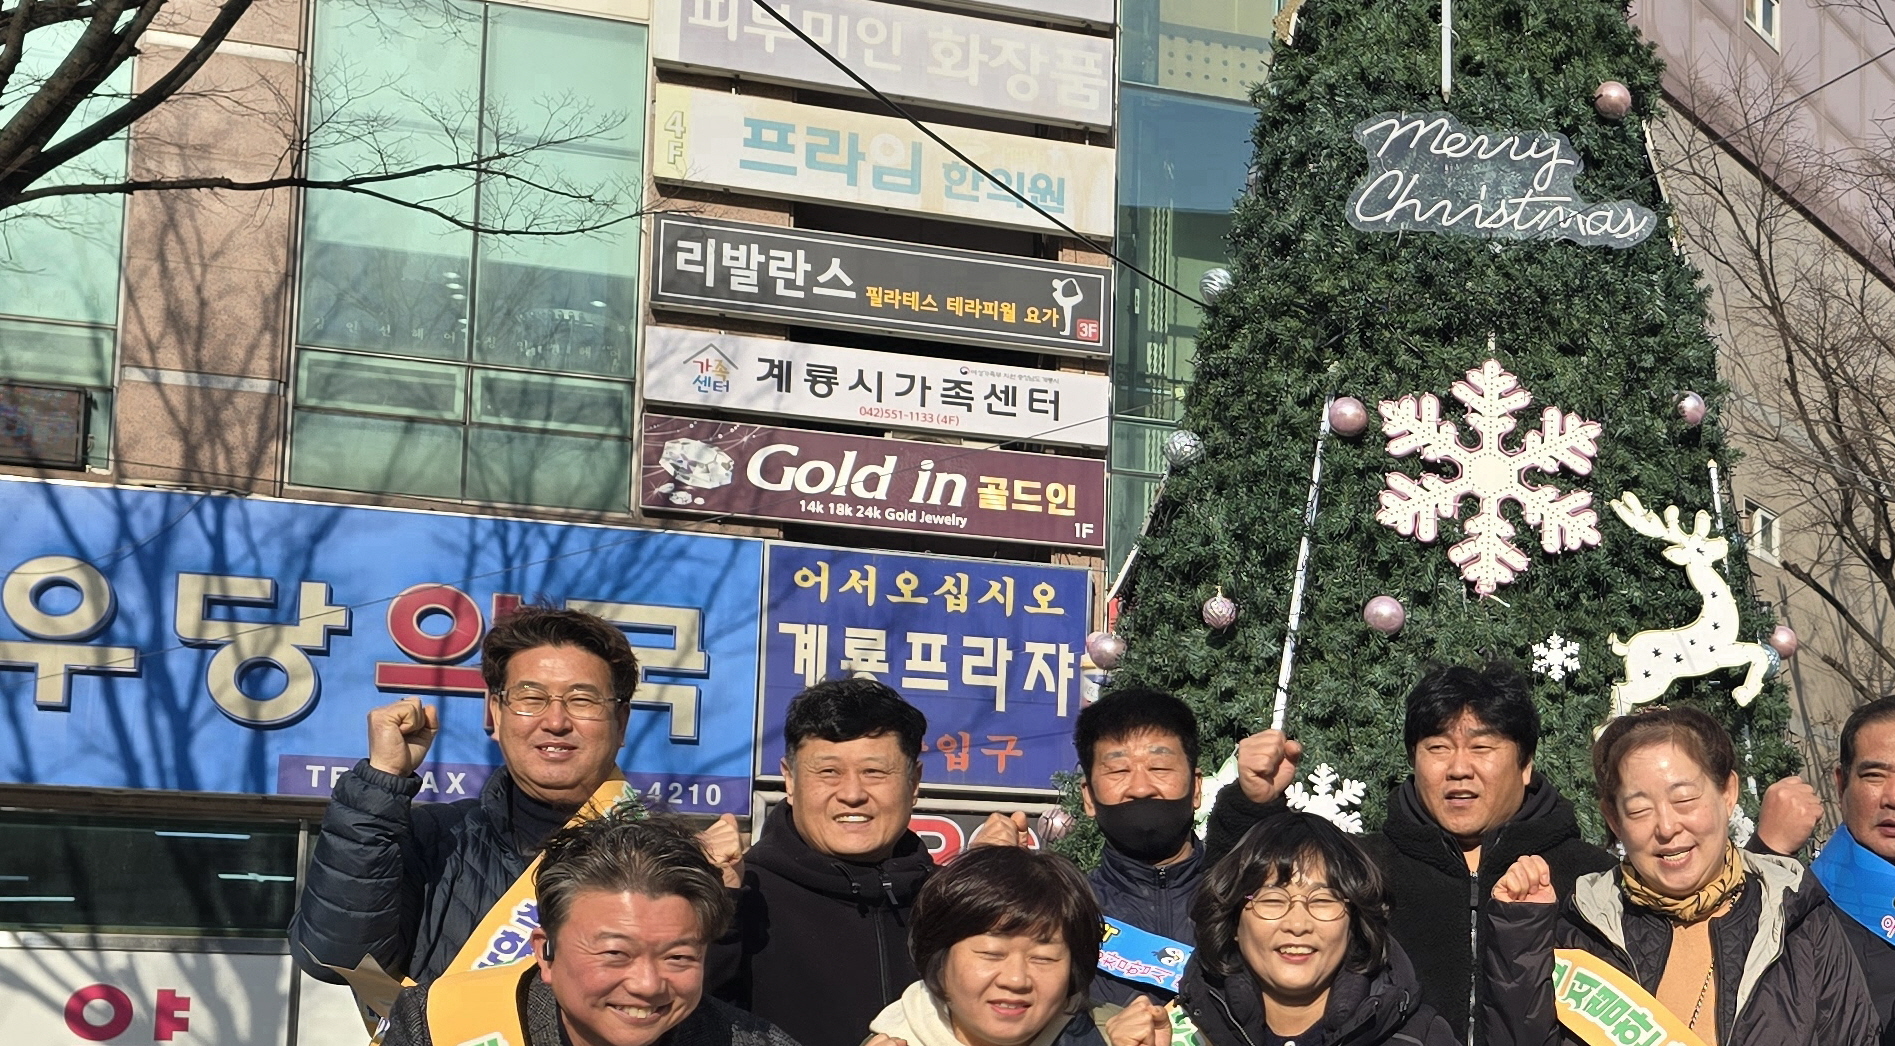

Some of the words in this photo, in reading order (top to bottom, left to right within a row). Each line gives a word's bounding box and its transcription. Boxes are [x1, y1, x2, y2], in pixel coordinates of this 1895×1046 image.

[927, 26, 1108, 110] 화장품
[739, 117, 922, 195] 프라임
[942, 161, 1065, 214] 한의원
[1363, 118, 1574, 191] Merry
[1355, 170, 1647, 239] Christmas
[676, 239, 857, 299] 리발란스
[866, 286, 938, 312] 필라테스
[1024, 307, 1059, 328] 요가
[1079, 322, 1098, 338] 3F
[693, 358, 730, 381] 가족
[693, 375, 729, 393] 센터
[756, 357, 1061, 421] 계룡시가족센터
[859, 406, 934, 424] 042)551-1133
[936, 412, 960, 426] (4F)
[746, 443, 897, 500] Gold
[908, 459, 967, 507] in
[978, 475, 1076, 516] 골드인
[799, 499, 824, 514] 14k
[829, 502, 852, 517] 18k
[855, 505, 881, 519] 24k
[885, 508, 916, 522] Gold
[919, 510, 968, 529] Jewelry
[1074, 523, 1094, 538] 1F
[794, 561, 1065, 617] 어서오십시오
